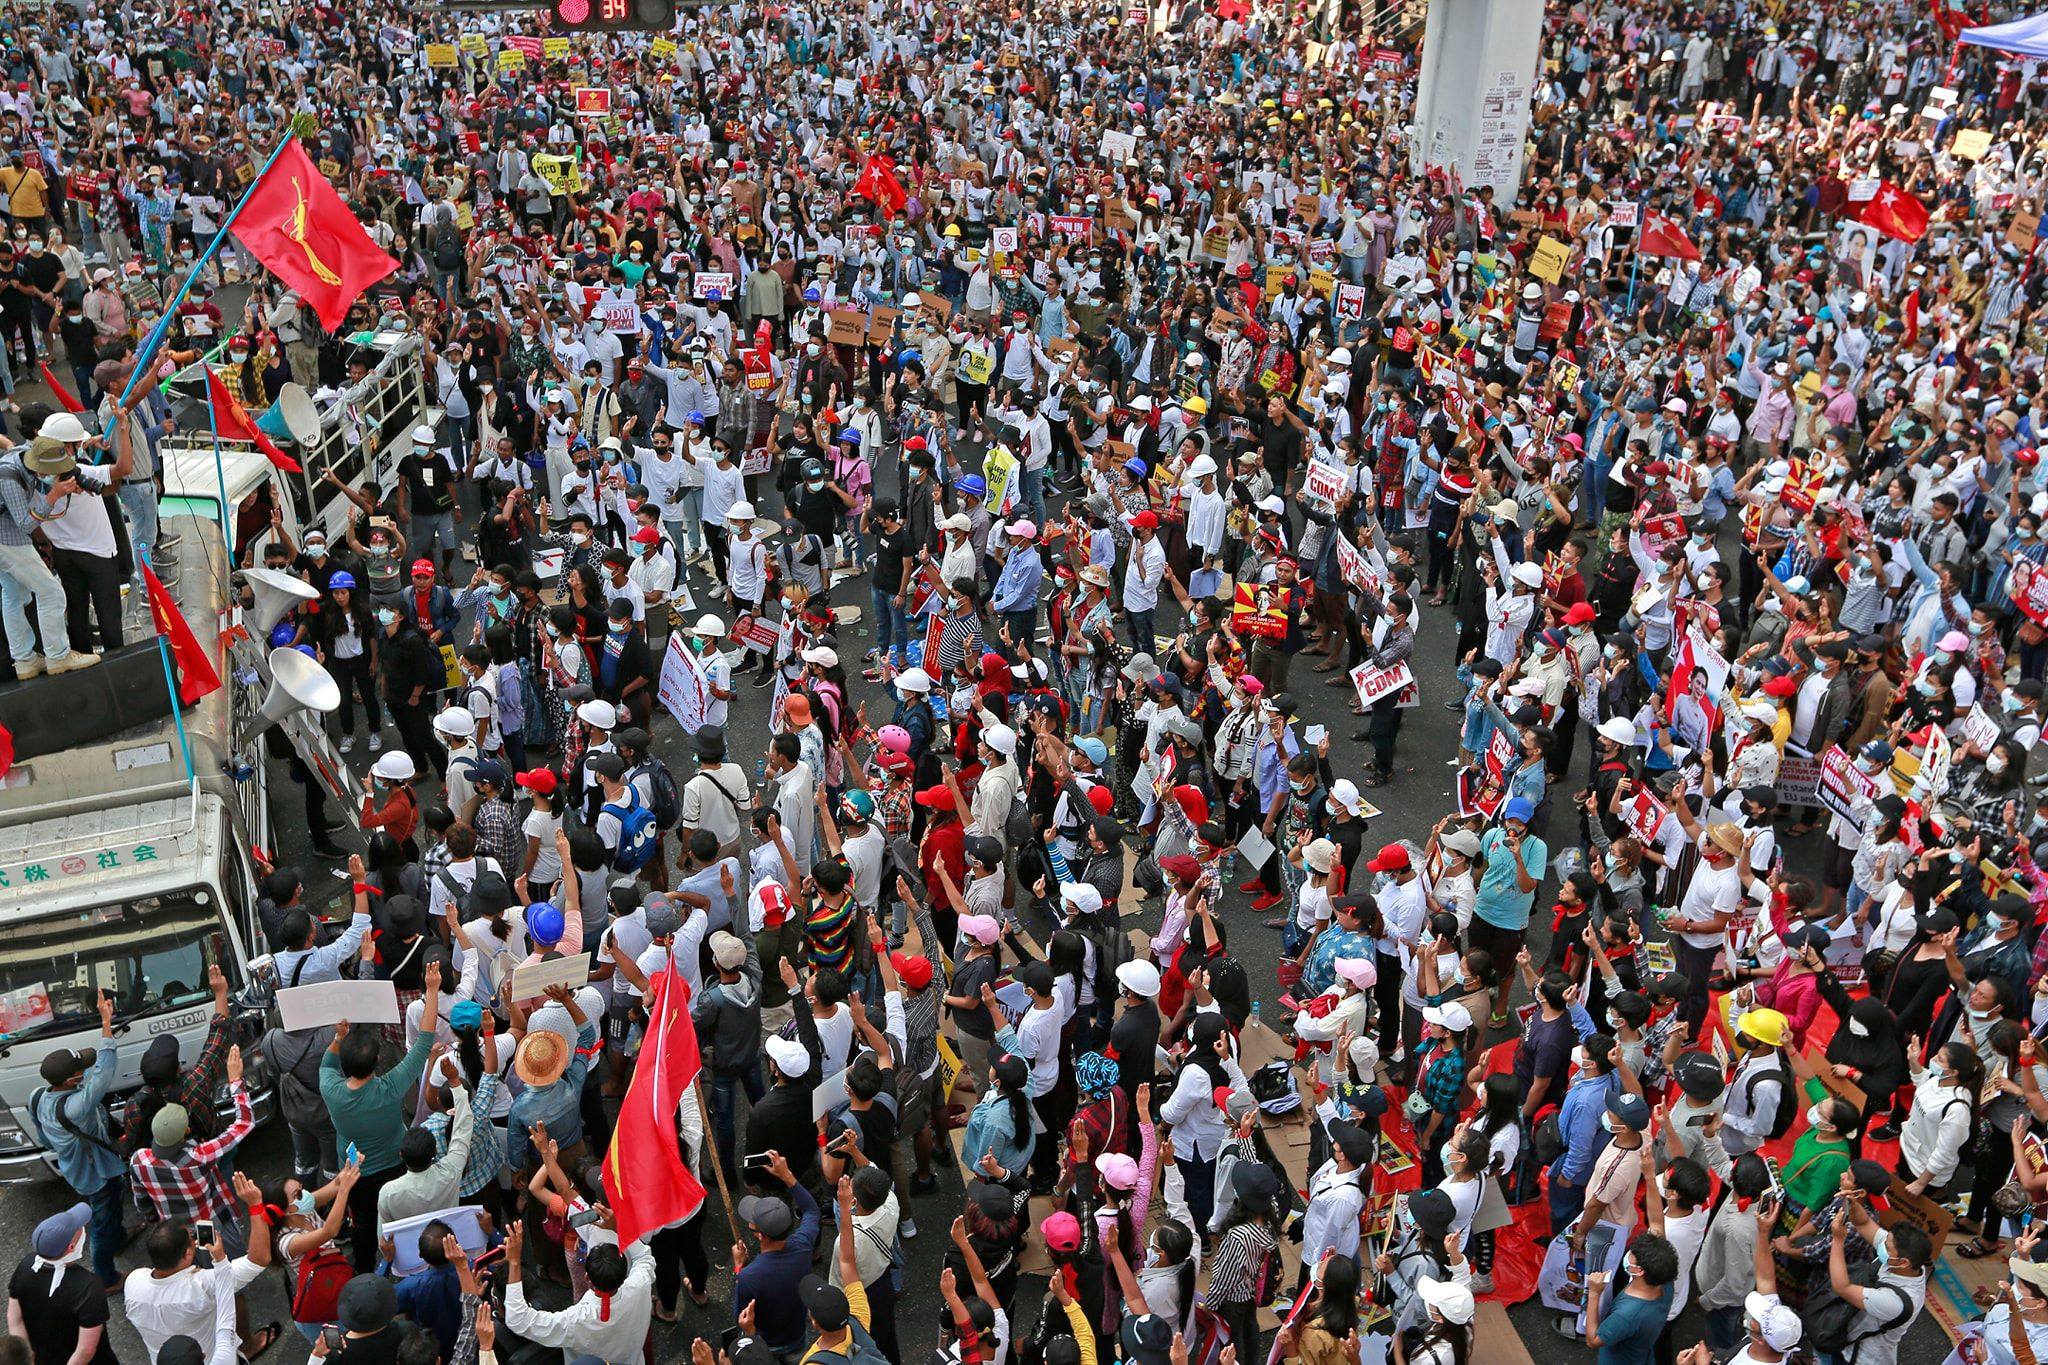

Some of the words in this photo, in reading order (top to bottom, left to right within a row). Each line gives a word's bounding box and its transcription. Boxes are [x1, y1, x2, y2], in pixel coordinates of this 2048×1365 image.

[603, 0, 626, 19] 34
[749, 379, 771, 388] COUP
[1310, 477, 1336, 501] CDM
[1691, 631, 1705, 649] FREE
[1706, 647, 1726, 671] BURMA
[1364, 666, 1404, 697] CDM
[1784, 793, 1797, 801] EU
[150, 1012, 205, 1033] CUSTOM
[942, 1058, 955, 1079] THE
